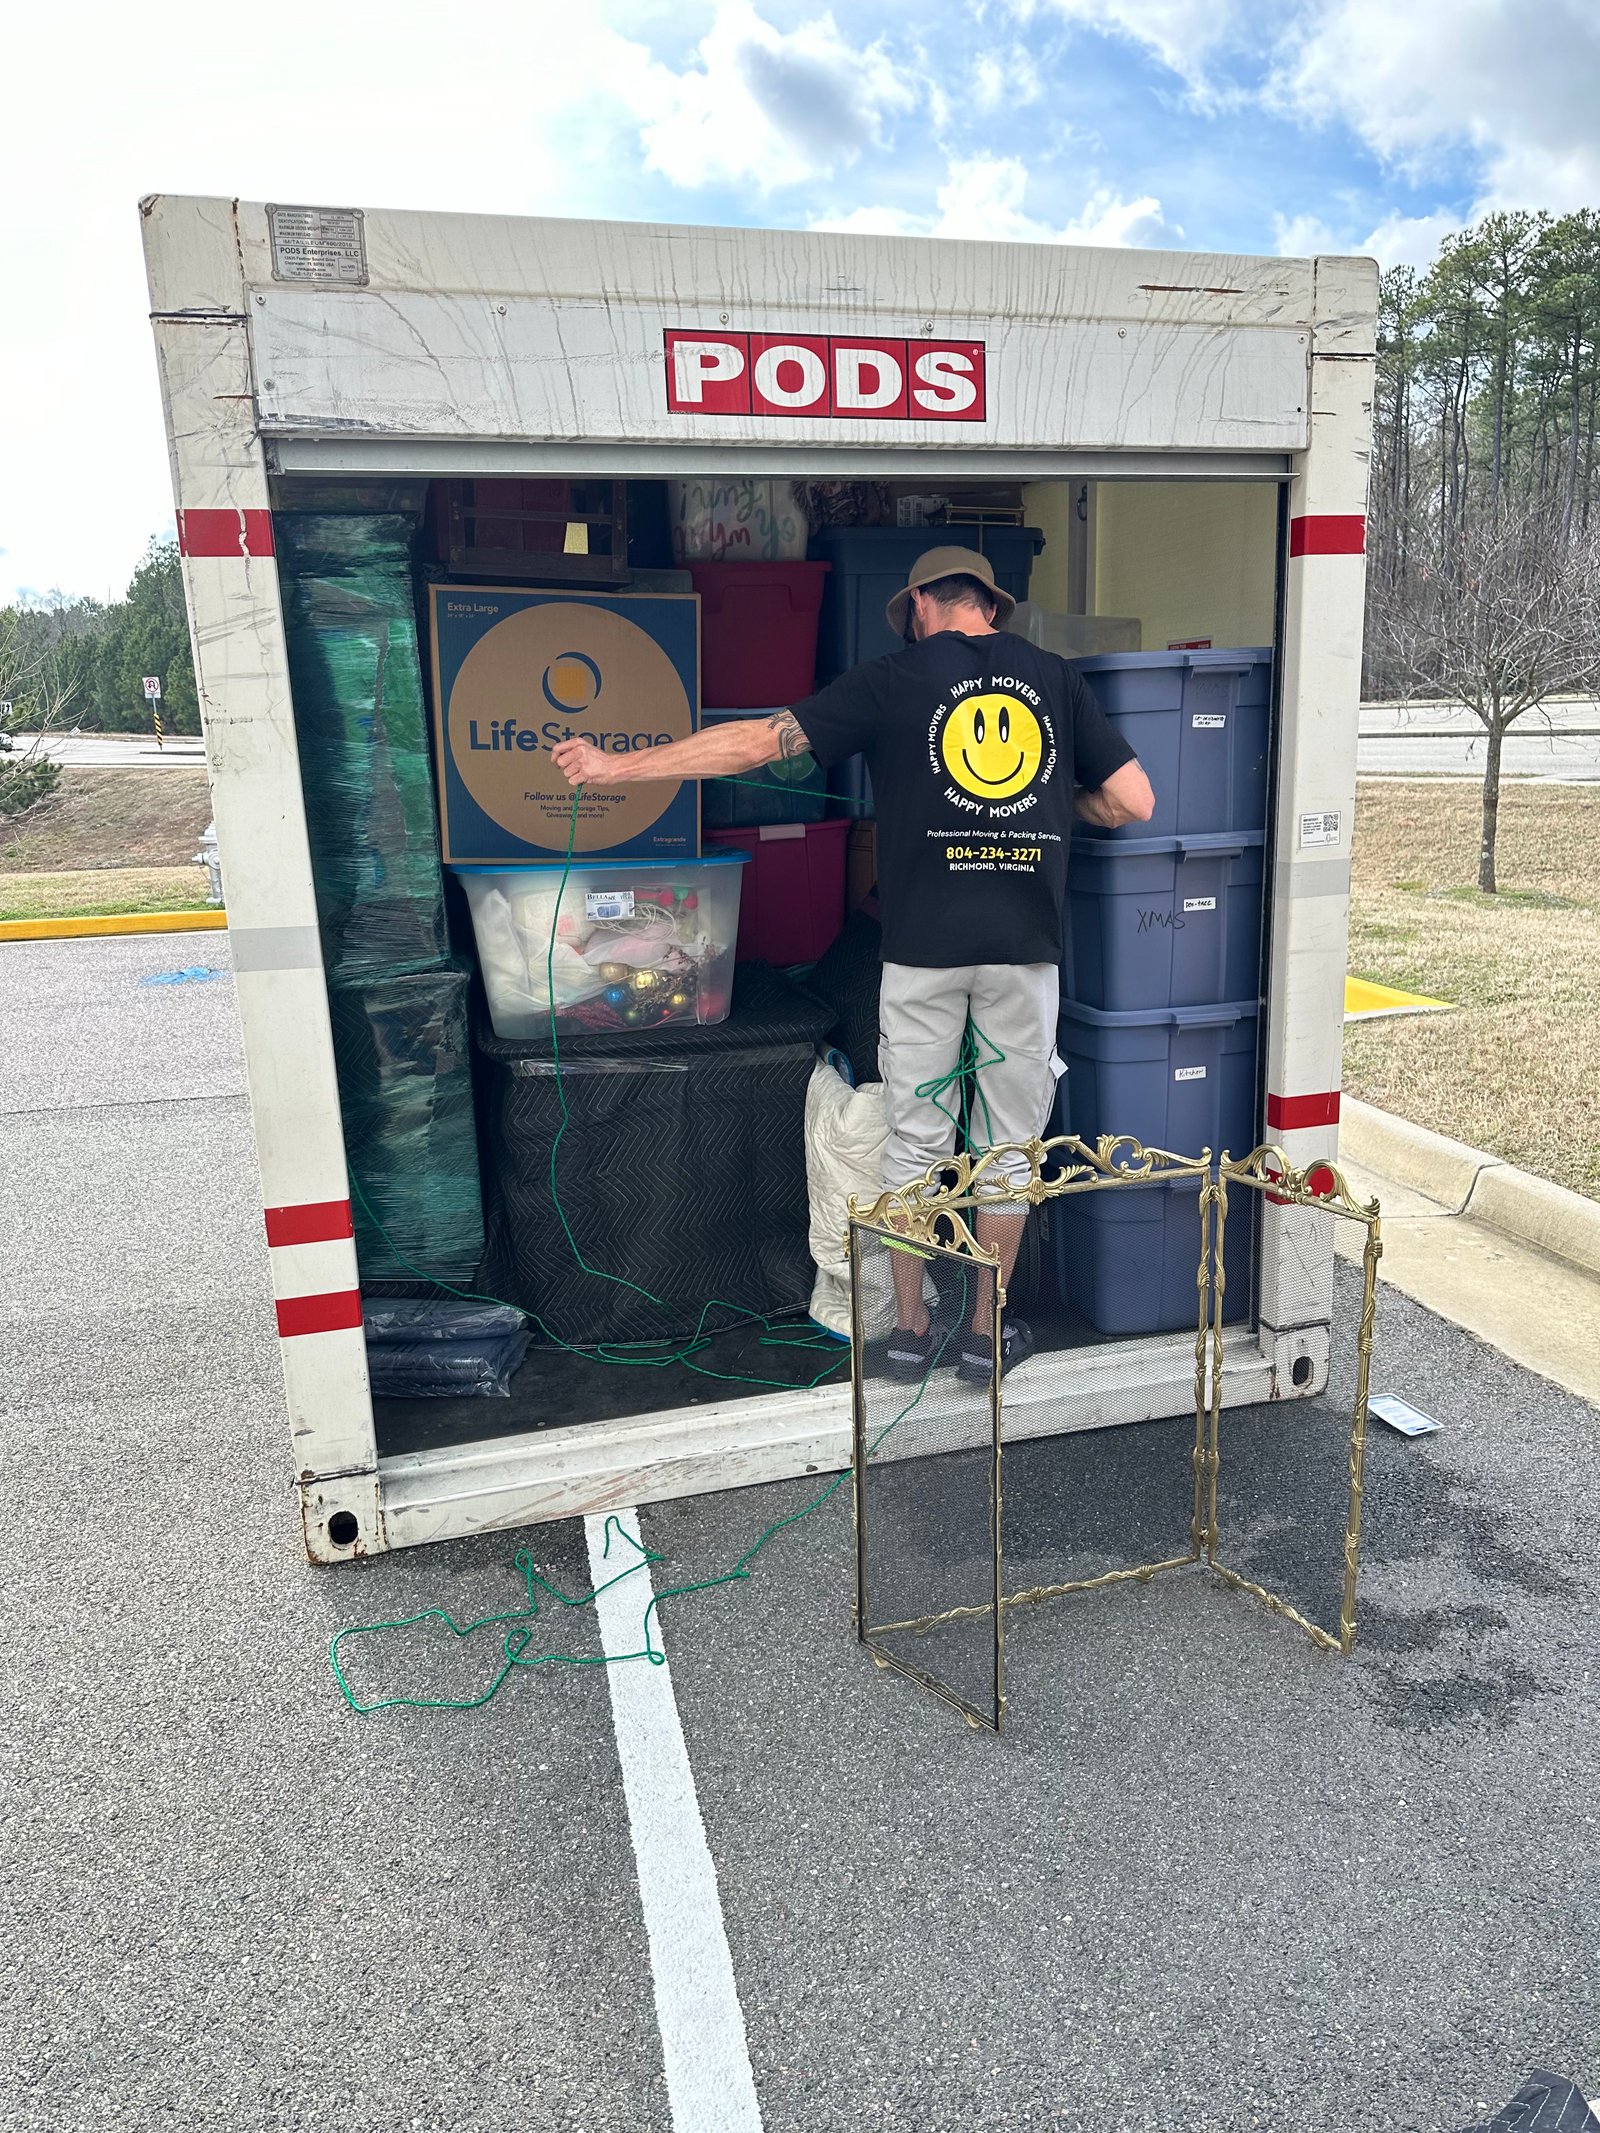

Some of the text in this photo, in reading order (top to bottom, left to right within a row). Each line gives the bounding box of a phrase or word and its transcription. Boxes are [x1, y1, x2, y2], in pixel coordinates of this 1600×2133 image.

[280, 247, 301, 255] PODS
[673, 340, 977, 412] PODS
[447, 602, 499, 615] Extra Large
[950, 676, 1042, 706] HAPPY MOVERS
[928, 703, 948, 775] HAPPY MOVERS
[1040, 714, 1057, 785] HAPPY MOVERS
[524, 792, 554, 801] Follow
[568, 792, 626, 804] @LifeStorage
[943, 786, 1038, 818] HAPPY MOVERS
[927, 830, 972, 838] Professional
[972, 830, 999, 839] Moving
[1008, 831, 1036, 841] Packing
[946, 846, 1042, 862] 804-234-3271
[949, 863, 1035, 873] RICHMOND, VIRGINIA
[1137, 908, 1186, 934] XMAS
